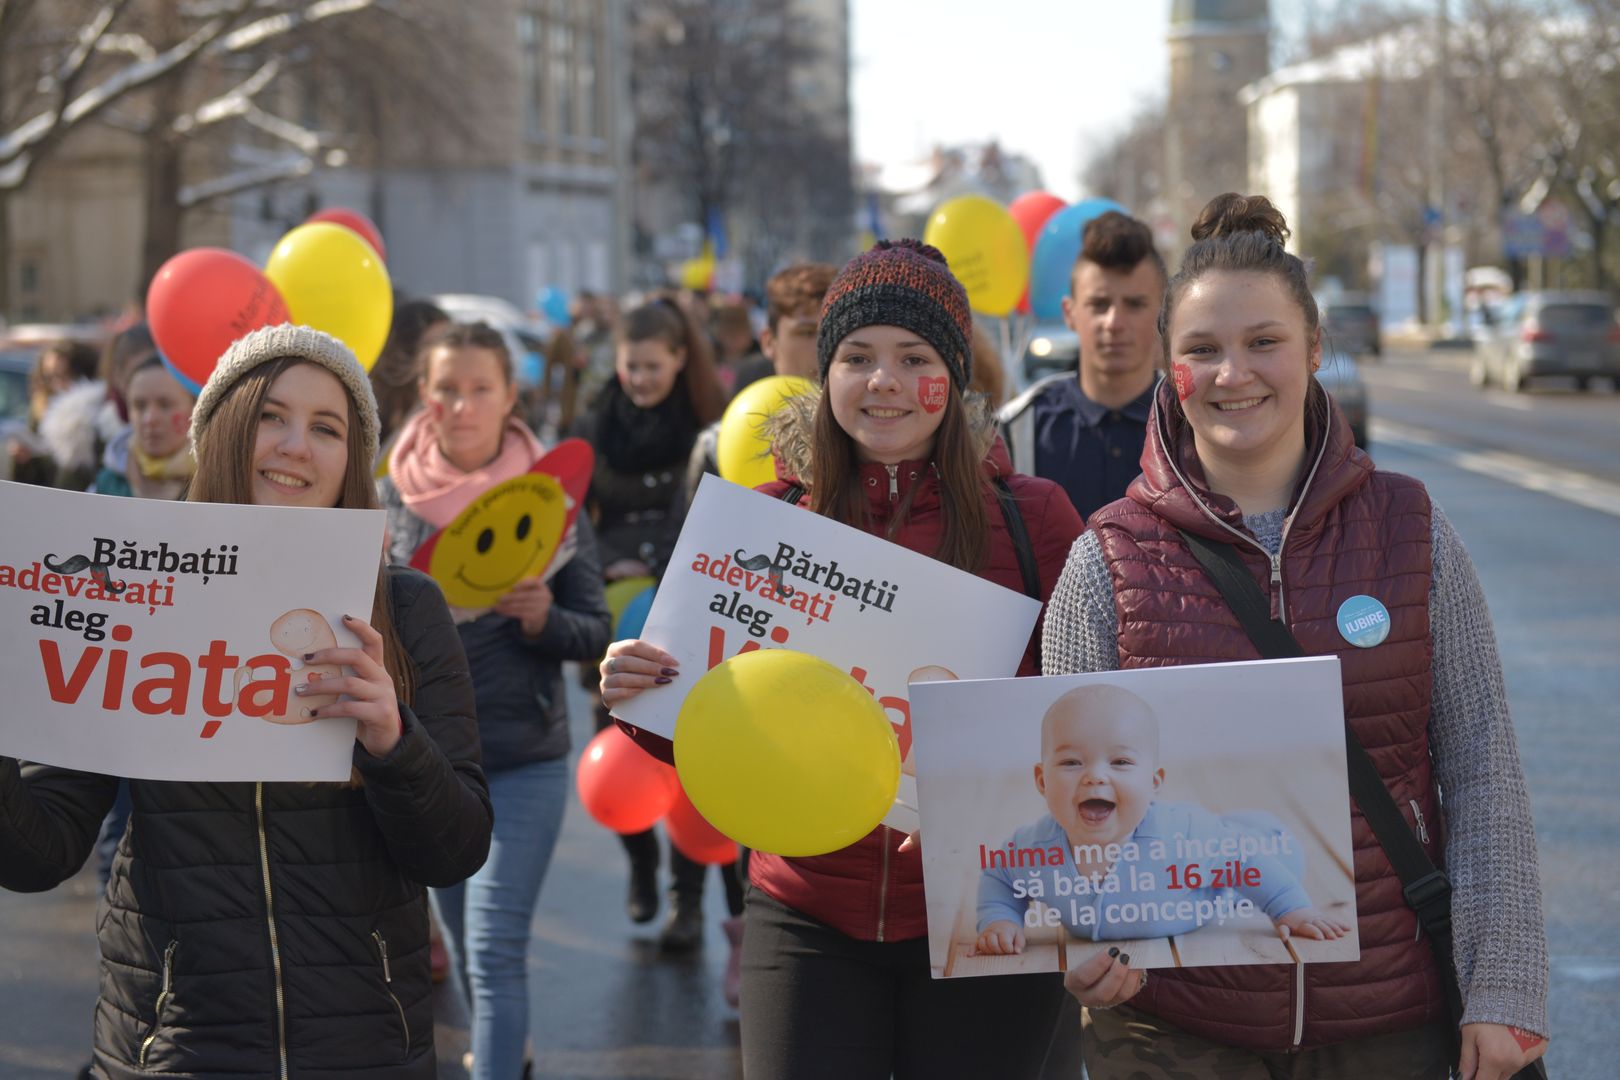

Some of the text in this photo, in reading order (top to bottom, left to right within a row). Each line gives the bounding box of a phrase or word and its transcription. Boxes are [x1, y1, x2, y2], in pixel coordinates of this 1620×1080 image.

[93, 536, 239, 585] Bărbații
[772, 541, 899, 613] Bărbații
[0, 562, 175, 616] adevărați
[691, 552, 837, 626] adevărați
[30, 600, 109, 642] aleg
[709, 591, 774, 638] aleg
[1345, 611, 1385, 634] IUBIRE
[39, 624, 292, 739] viața
[979, 831, 1294, 870] Inima mea a început
[1012, 860, 1262, 899] să bată la 16 zile
[1024, 892, 1254, 928] de la concepție
